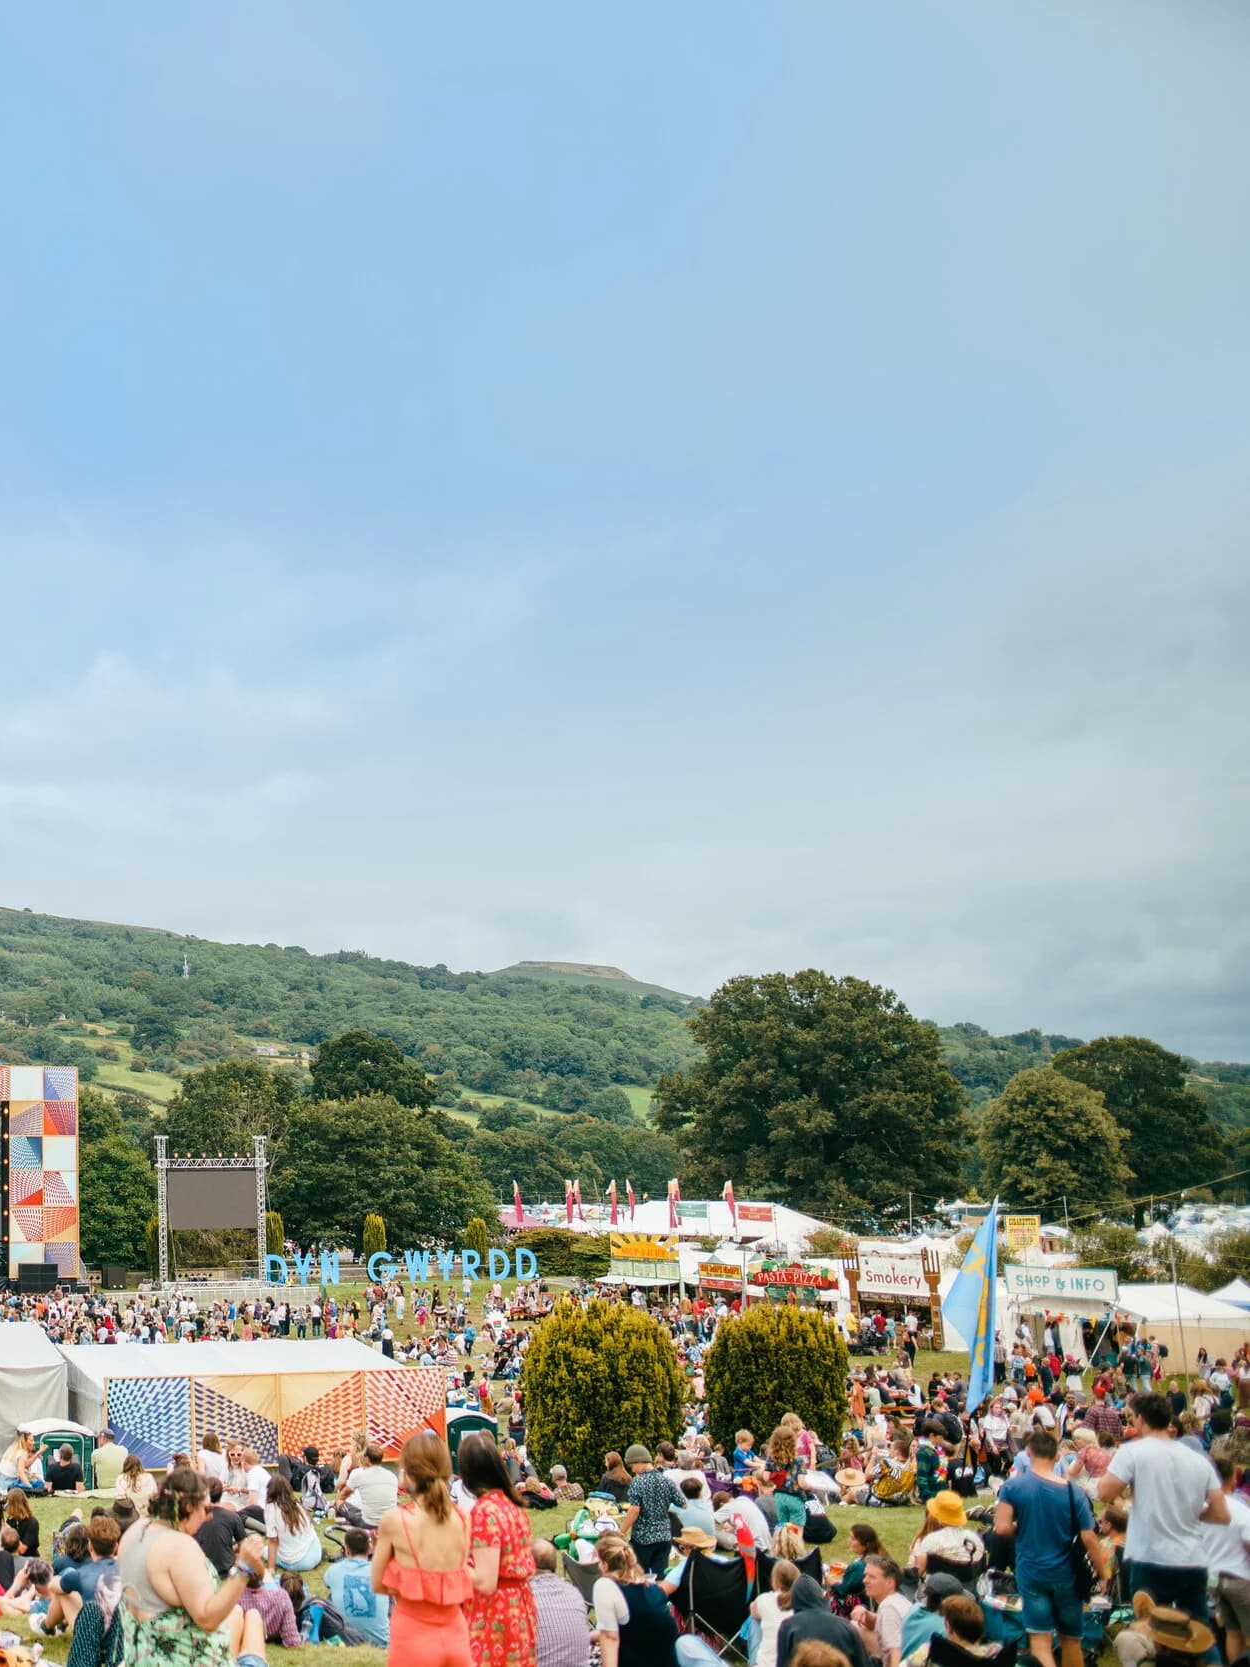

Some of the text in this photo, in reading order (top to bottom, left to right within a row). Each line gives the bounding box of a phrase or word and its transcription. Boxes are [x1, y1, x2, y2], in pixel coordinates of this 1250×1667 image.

[266, 1247, 537, 1286] DYN GWYRDD
[866, 1264, 921, 1290] Smokery
[757, 1271, 823, 1286] PASTA PIZZA
[1015, 1274, 1050, 1288] SHOP
[1070, 1279, 1105, 1292] INFO
